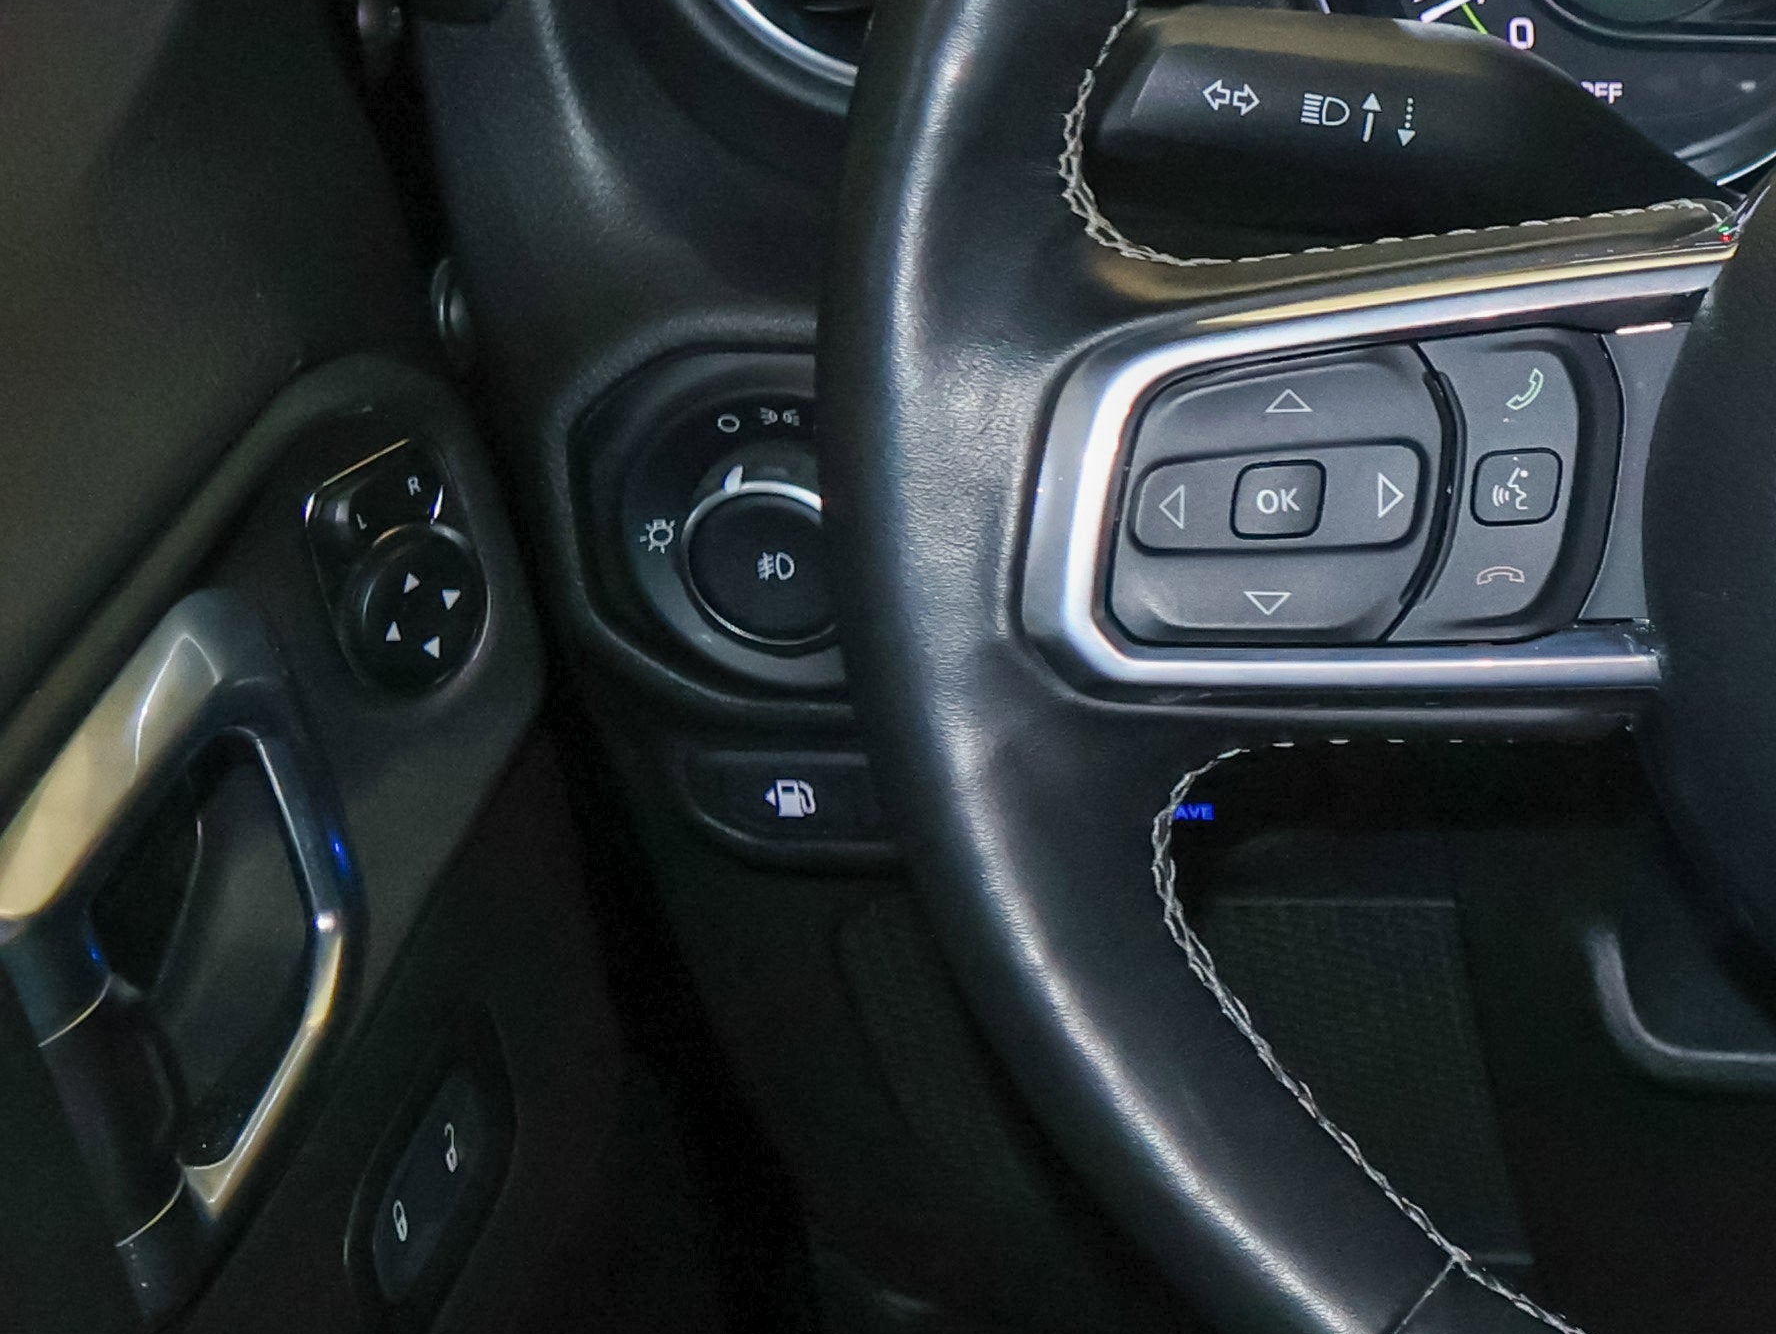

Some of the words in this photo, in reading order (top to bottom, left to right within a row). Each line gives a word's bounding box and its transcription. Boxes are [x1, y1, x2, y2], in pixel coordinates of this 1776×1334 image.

[1509, 18, 1534, 50] 0
[407, 475, 421, 496] R
[1255, 488, 1301, 514] OK
[356, 513, 367, 530] L
[1173, 803, 1215, 821] AVE
